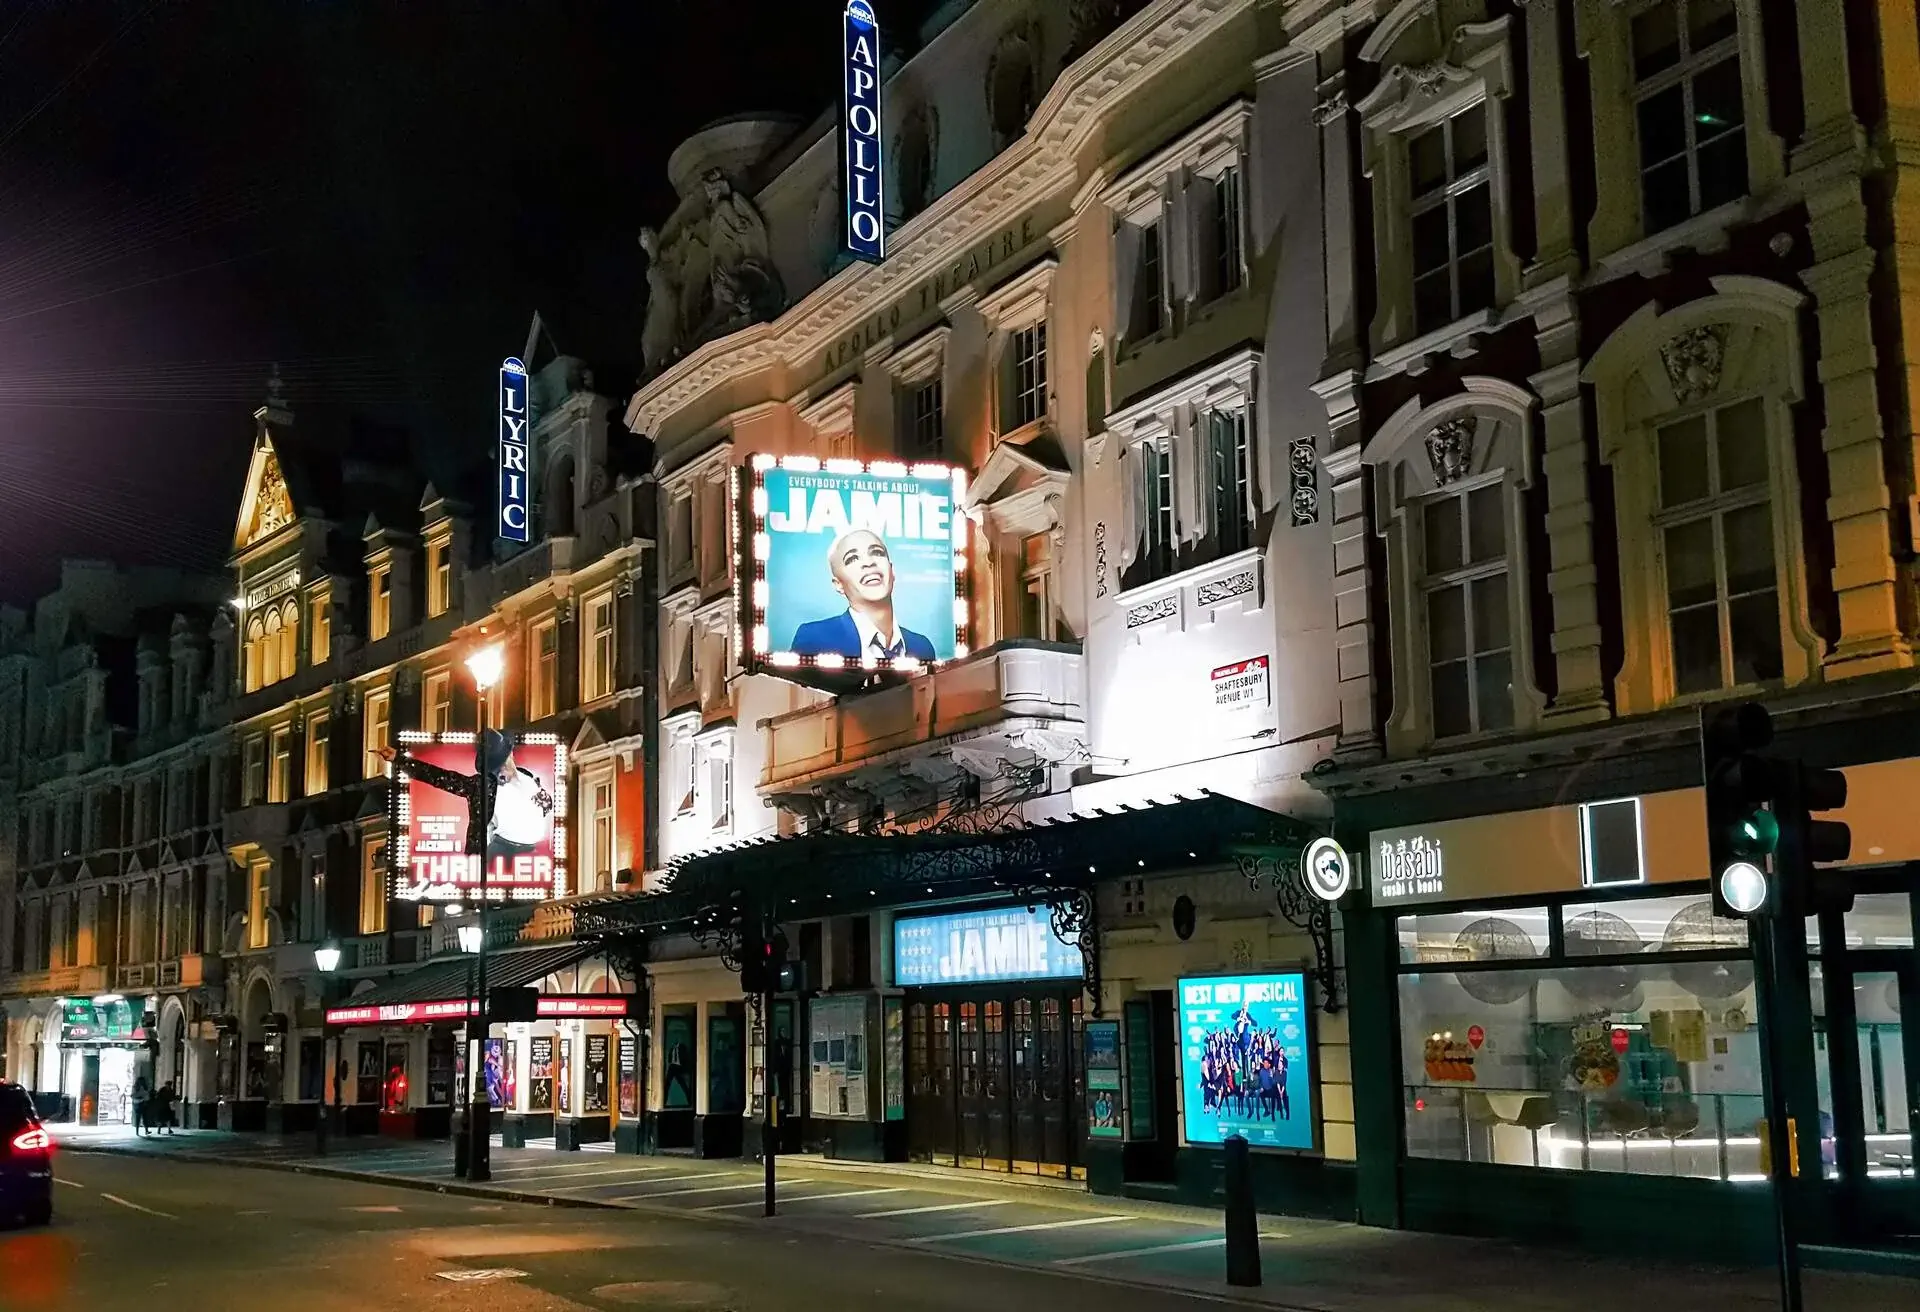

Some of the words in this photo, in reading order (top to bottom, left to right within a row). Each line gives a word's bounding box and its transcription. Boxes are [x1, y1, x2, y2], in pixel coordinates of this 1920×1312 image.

[850, 36, 879, 242] APOLLO
[825, 306, 900, 375] APOLLO
[919, 216, 1035, 312] THEATRE
[503, 387, 527, 529] LYRIC
[788, 476, 849, 490] EVERYBODY'S
[852, 479, 889, 493] TALKING
[891, 482, 919, 494] ABOUT
[769, 487, 949, 540] JAMIE
[1215, 673, 1263, 693] SHAFTESBURY
[1215, 691, 1241, 704] AVENUE
[1243, 688, 1254, 699] W1
[1381, 840, 1442, 881] wasabi
[1382, 880, 1405, 897] sushi
[1417, 879, 1443, 894] bento
[939, 921, 1048, 977] JAMIE
[71, 1028, 88, 1036] ATM
